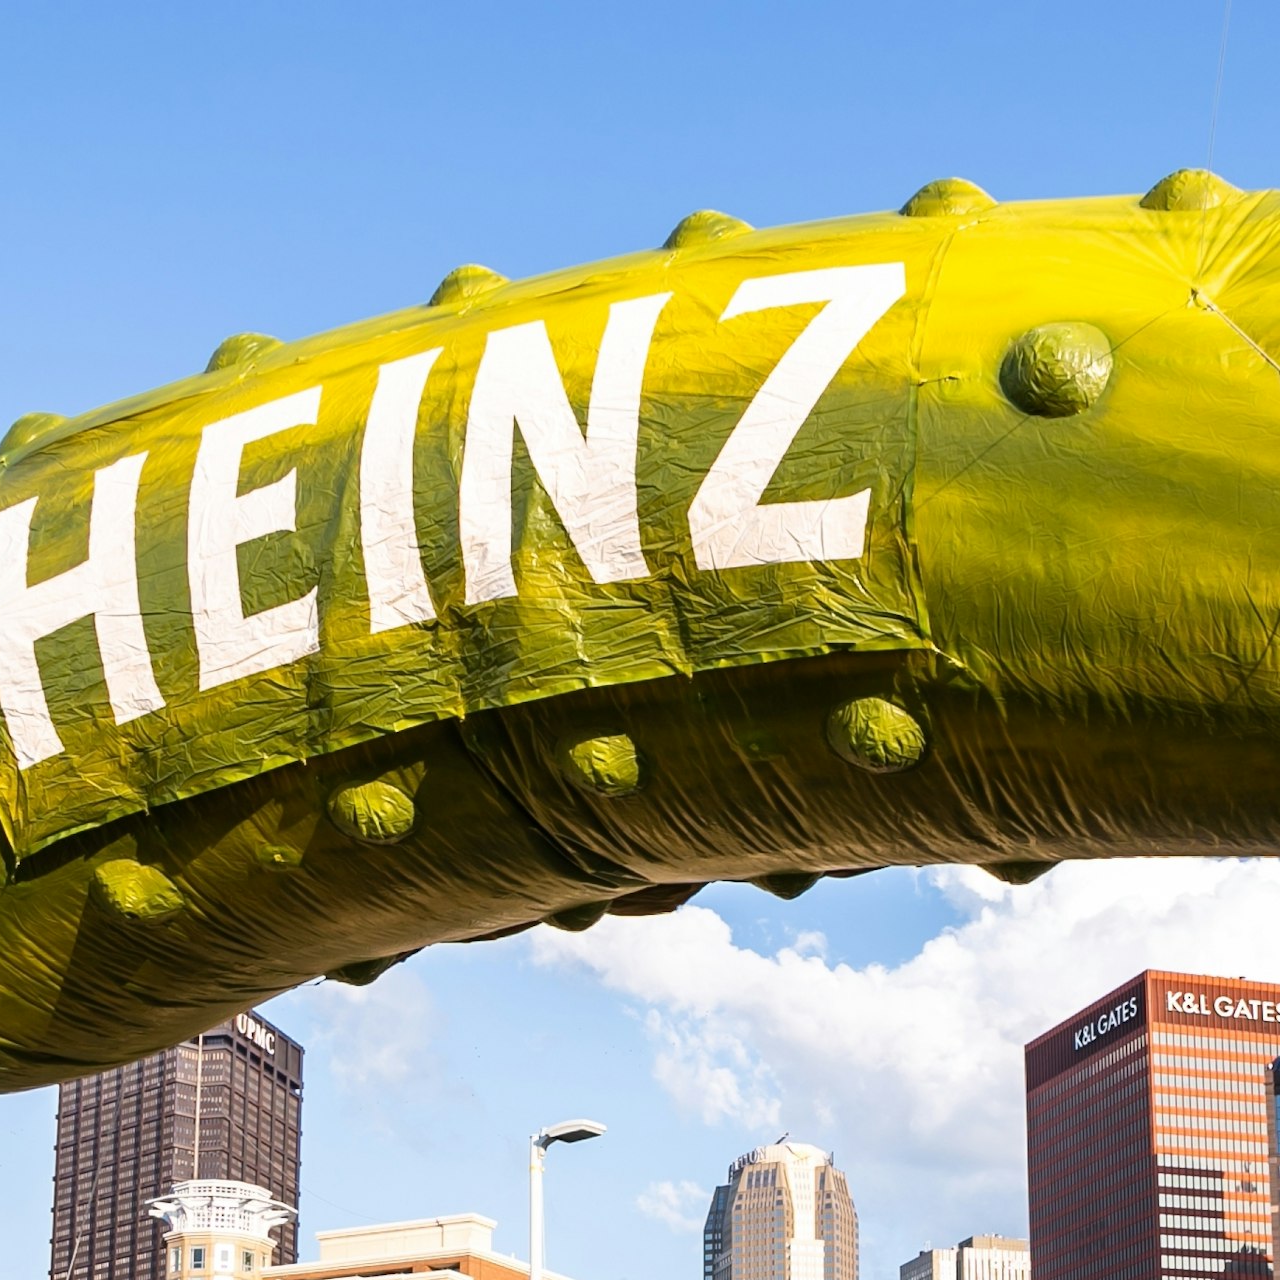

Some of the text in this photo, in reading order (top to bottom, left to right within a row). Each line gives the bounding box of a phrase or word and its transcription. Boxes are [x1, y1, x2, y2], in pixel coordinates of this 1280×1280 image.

[1074, 997, 1138, 1050] K&L GATES
[1167, 991, 1210, 1015] K&L
[236, 1013, 275, 1055] UPMC
